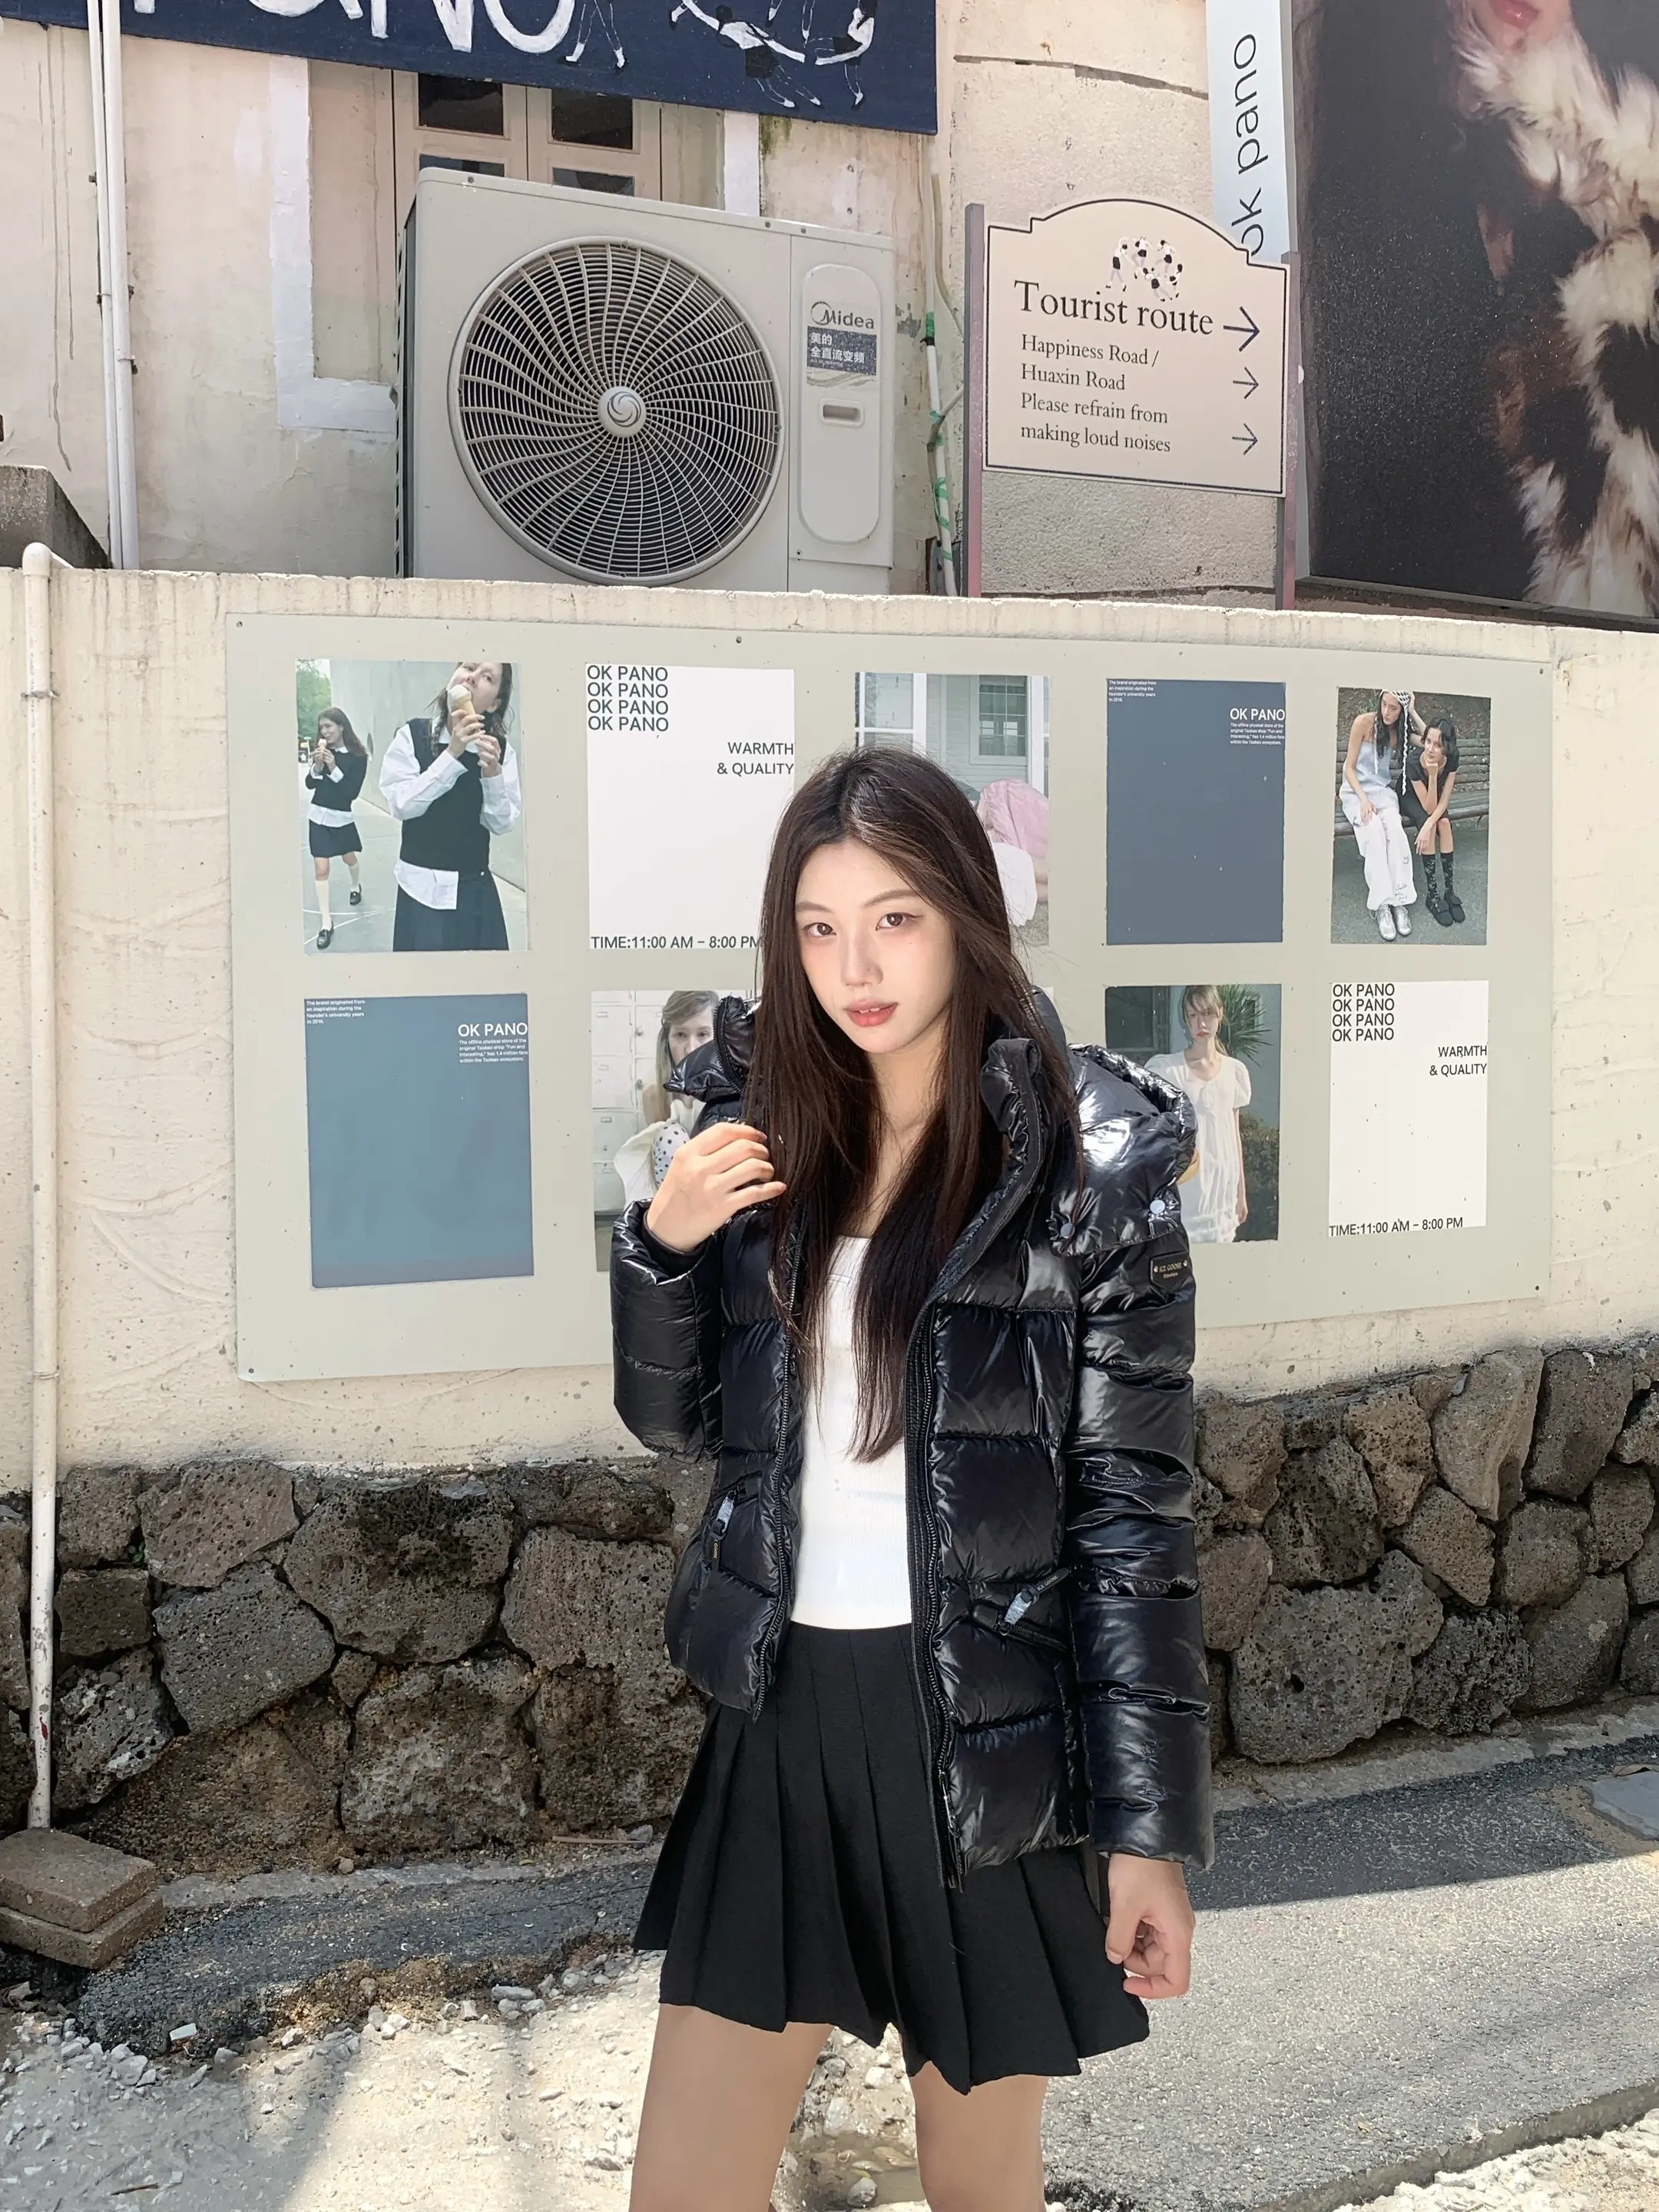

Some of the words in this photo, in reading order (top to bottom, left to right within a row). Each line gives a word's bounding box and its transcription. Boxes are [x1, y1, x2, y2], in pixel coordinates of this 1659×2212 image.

[1233, 34, 1268, 175] pano
[810, 300, 874, 329] Midea
[1014, 280, 1128, 324] Tourist
[1137, 306, 1214, 335] route
[810, 332, 833, 346] 美的
[810, 346, 865, 364] 全直流变频
[1022, 333, 1104, 359] Happiness
[1109, 344, 1148, 364] Road
[1022, 363, 1080, 386] Huaxin
[1086, 370, 1124, 390] Road
[1022, 392, 1069, 412] Please
[1075, 399, 1125, 419] refrain
[1131, 403, 1168, 423] from
[1021, 422, 1080, 448] making
[1084, 427, 1119, 447] loud
[1124, 434, 1171, 452] noises
[587, 665, 613, 680] OK
[618, 666, 668, 681] PANO
[588, 682, 613, 697] OK
[618, 683, 668, 698] PANO
[588, 699, 613, 714] OK
[618, 700, 668, 715] PANO
[1230, 708, 1247, 720] OK
[1251, 708, 1285, 720] PANO
[588, 716, 614, 730] OK
[619, 717, 669, 731] PANO
[727, 742, 794, 755] WARMTH
[717, 763, 727, 774] &
[732, 763, 794, 777] QUALITY
[591, 936, 667, 949] TIME:11:00
[671, 936, 693, 948] AM
[709, 936, 736, 949] 8:00
[740, 936, 762, 948] PM
[1333, 984, 1352, 997] OK
[1356, 983, 1395, 997] PANO
[1333, 999, 1352, 1012] OK
[1356, 998, 1395, 1012] PANO
[1333, 1014, 1352, 1026] OK
[1356, 1013, 1394, 1026] PANO
[458, 1024, 481, 1037] OK
[484, 1022, 528, 1036] PANO
[1333, 1029, 1352, 1041] OK
[1356, 1028, 1394, 1041] PANO
[1438, 1045, 1487, 1057] WARMTH
[1429, 1065, 1438, 1076] &
[1441, 1064, 1487, 1077] QUALITY
[1329, 1222, 1388, 1237] TIME:11:00
[1392, 1220, 1409, 1232] AM
[1422, 1218, 1443, 1230] 8:00
[1446, 1217, 1463, 1228] PM
